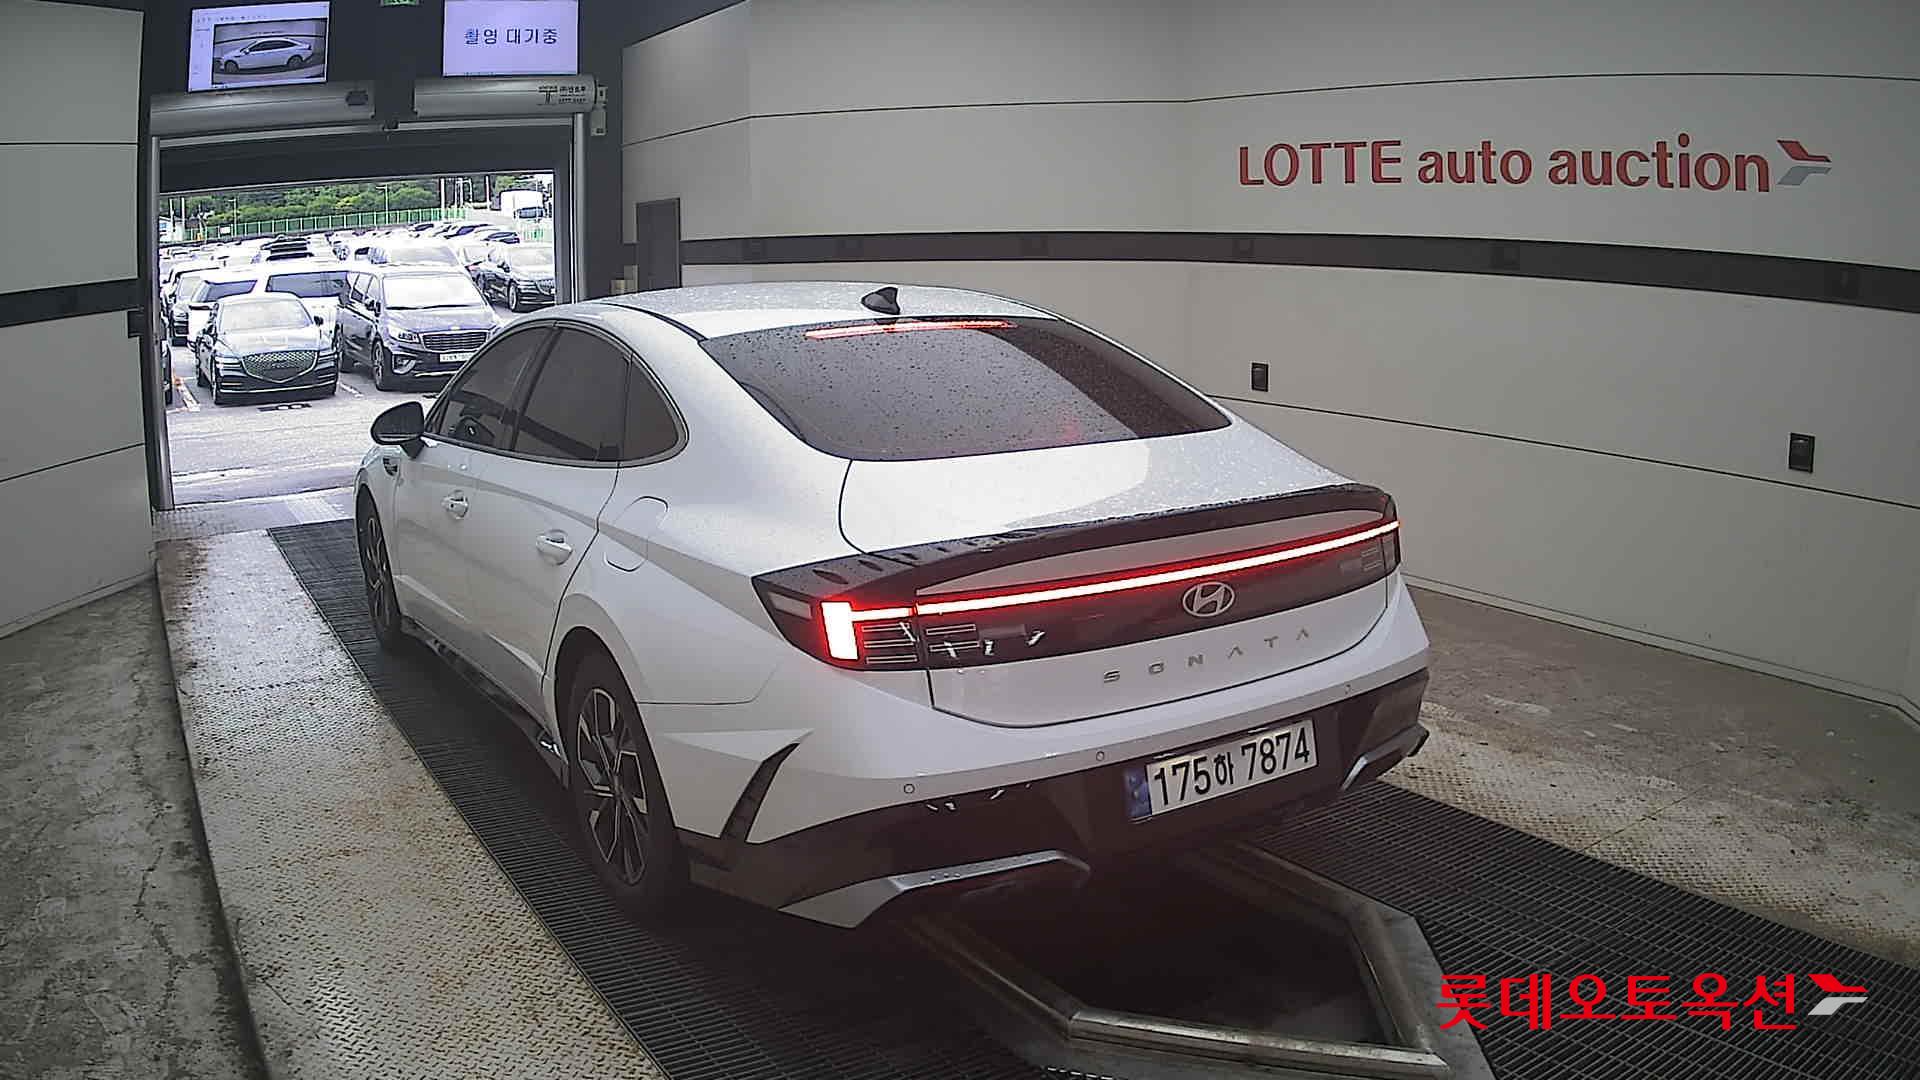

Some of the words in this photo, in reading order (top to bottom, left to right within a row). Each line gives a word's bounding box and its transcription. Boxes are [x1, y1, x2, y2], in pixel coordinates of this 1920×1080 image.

[465, 28, 496, 45] 촬영
[506, 28, 557, 45] 대기중
[1239, 139, 1403, 187] LOTTE
[1417, 140, 1533, 186] auto
[1549, 132, 1770, 193] auction
[1103, 628, 1309, 683] SONATA
[1154, 751, 1235, 805] 175하
[1241, 728, 1310, 780] 7874
